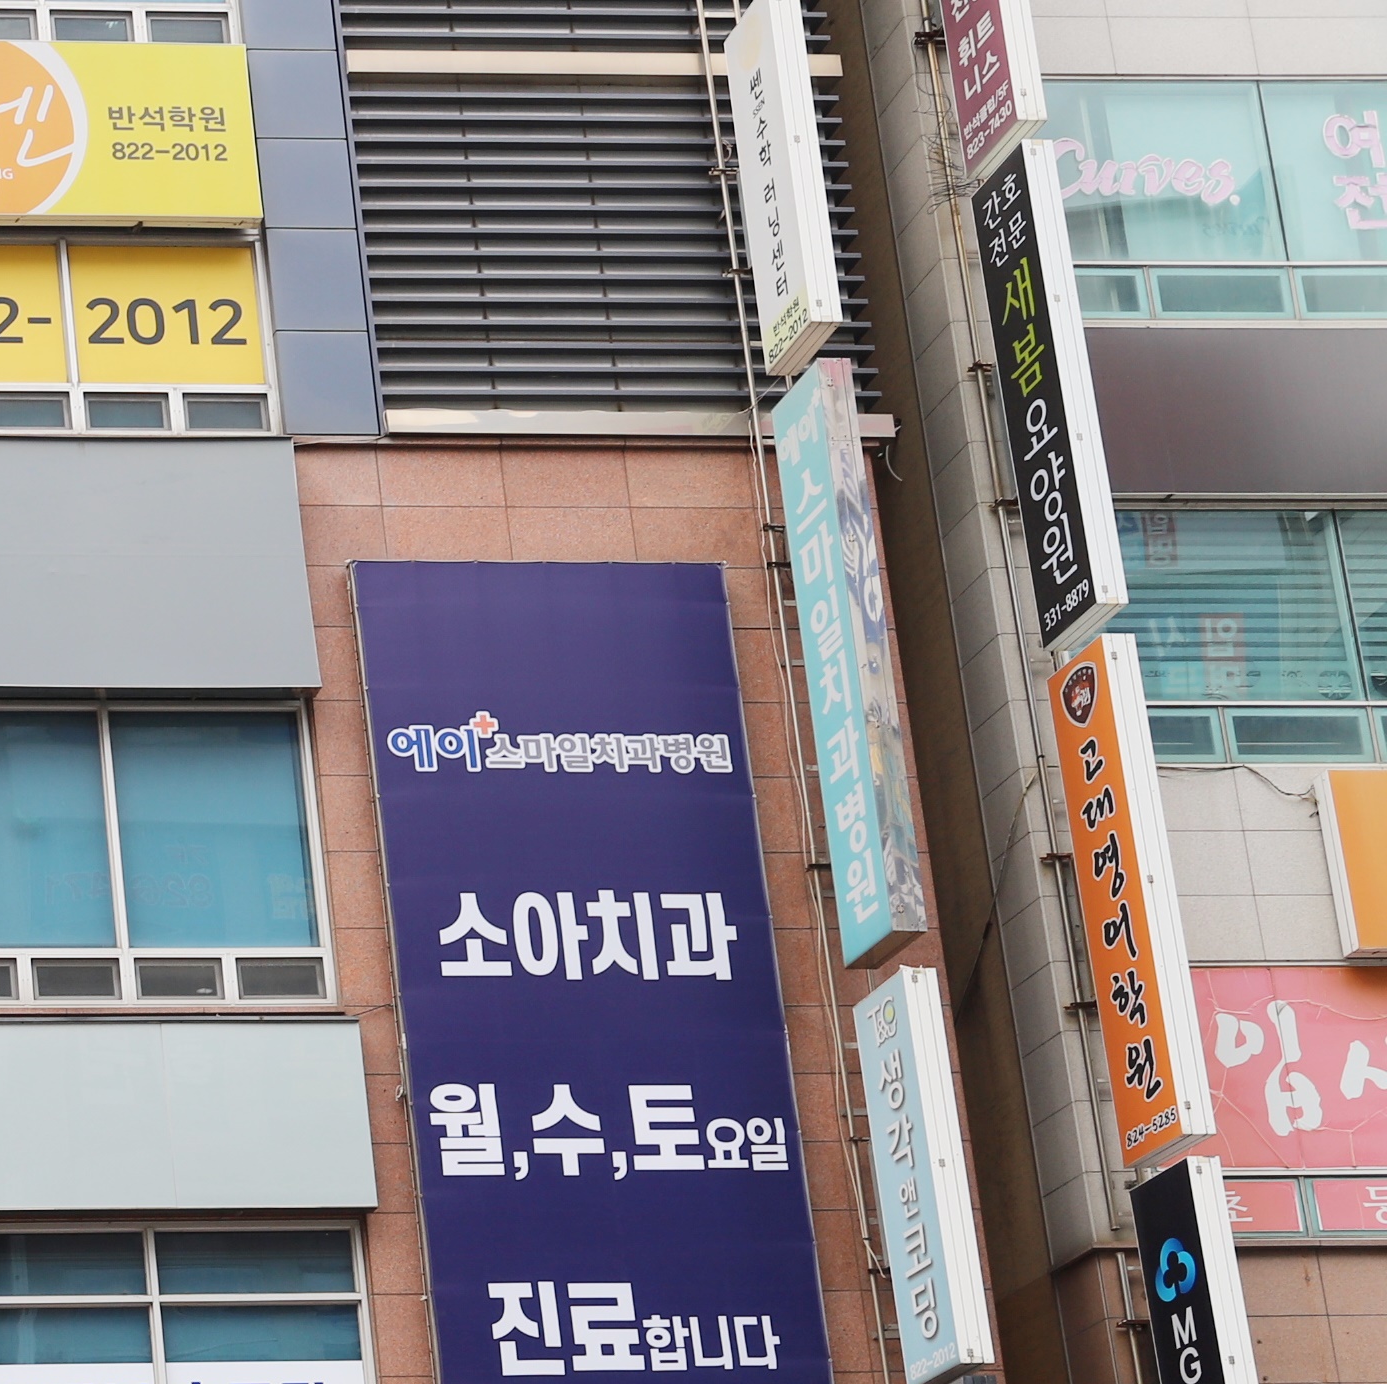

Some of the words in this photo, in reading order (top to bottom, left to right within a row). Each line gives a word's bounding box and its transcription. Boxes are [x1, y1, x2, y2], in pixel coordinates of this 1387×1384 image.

[107, 105, 227, 133] 반석학원
[966, 99, 1014, 160] 823-7430
[111, 142, 228, 163] 822-2012
[980, 171, 1023, 231] 간호
[763, 177, 789, 298] 러닝센터
[988, 213, 1028, 270] 전문
[768, 308, 809, 366] 822-2012
[772, 295, 801, 338] 반석학원
[1042, 577, 1092, 632] 331-8879
[437, 888, 739, 982] 소아치과
[1079, 737, 1163, 1099] 고대영어학원
[427, 1081, 791, 1182] 월,수,토요일
[1126, 1106, 1178, 1150] 824-5285
[878, 1048, 941, 1342] 생각앤코딩
[487, 1280, 782, 1378] 진료합니다
[910, 1342, 957, 1381] 822-2012
